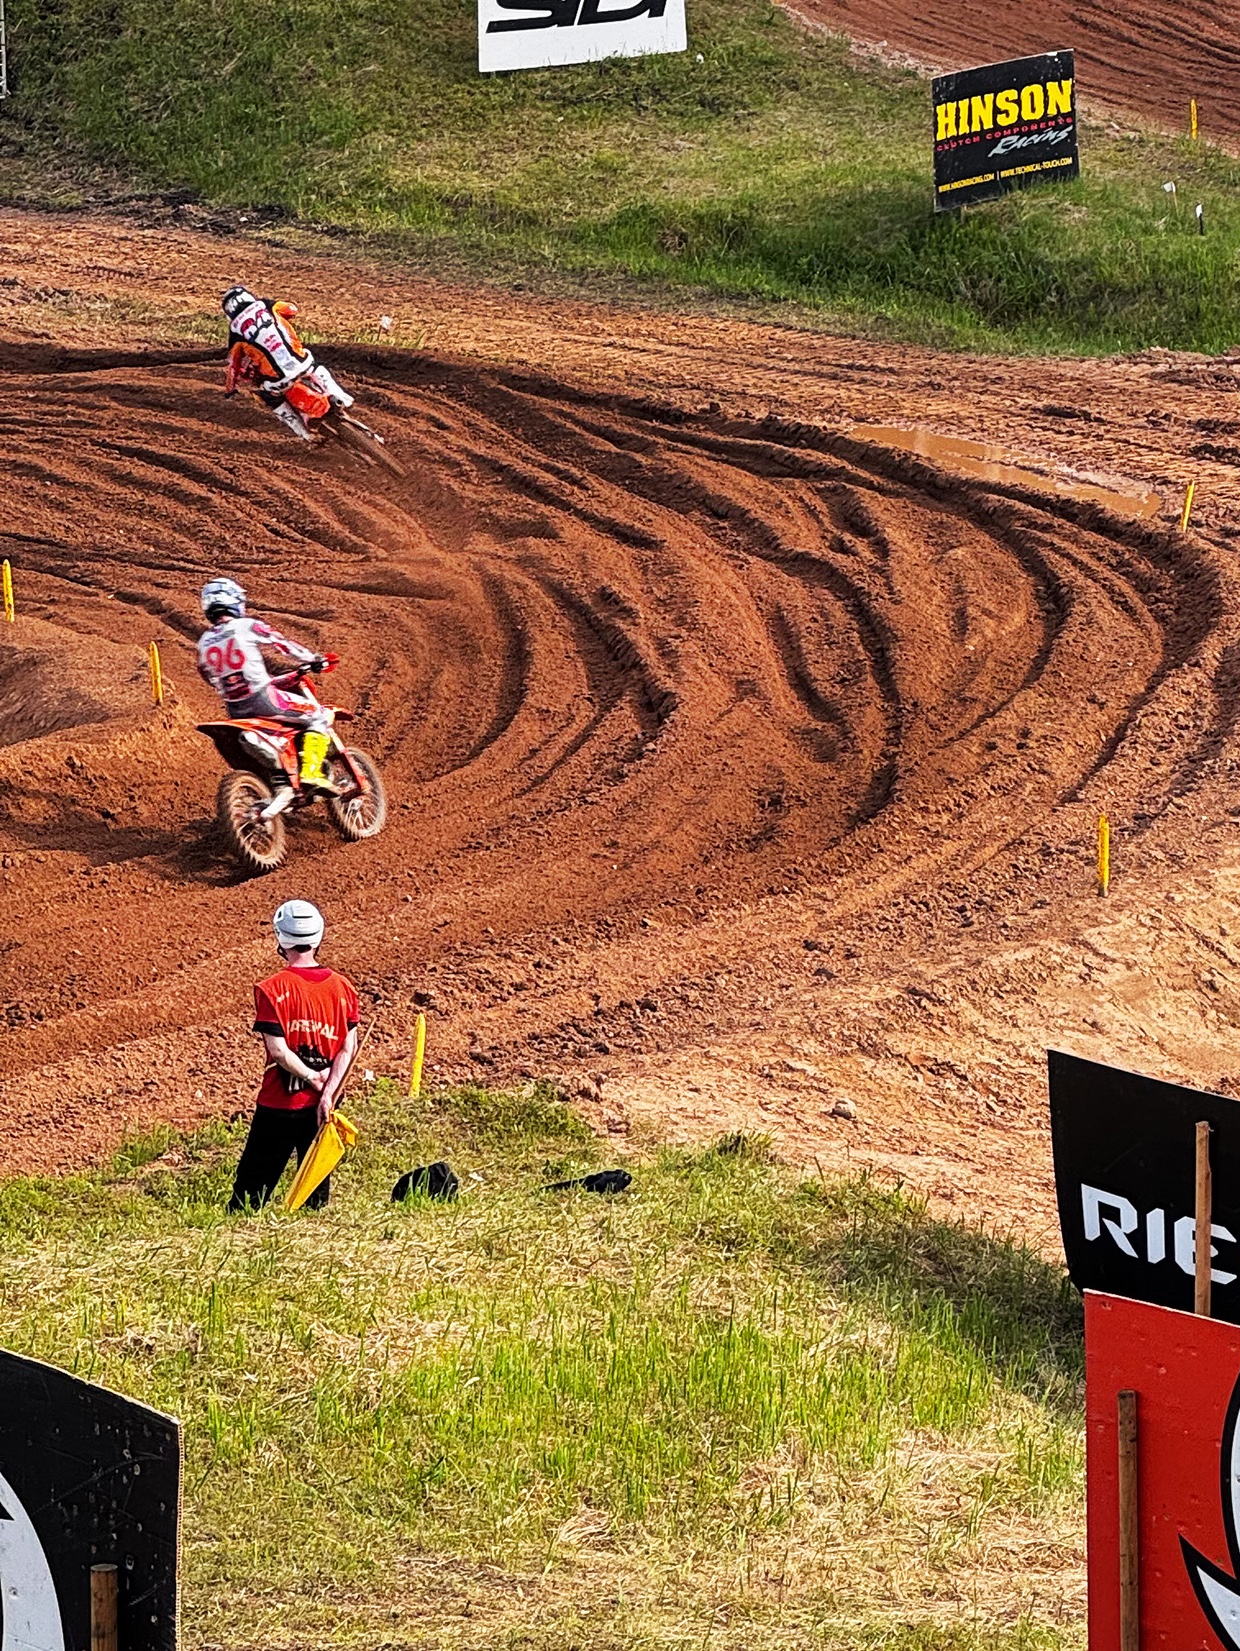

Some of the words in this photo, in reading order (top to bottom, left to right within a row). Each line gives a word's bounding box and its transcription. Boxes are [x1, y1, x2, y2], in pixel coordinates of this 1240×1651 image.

[936, 78, 1073, 141] HINSON
[936, 136, 981, 152] CLUTCH
[985, 117, 1073, 140] COMPONENTS
[206, 637, 245, 674] 96
